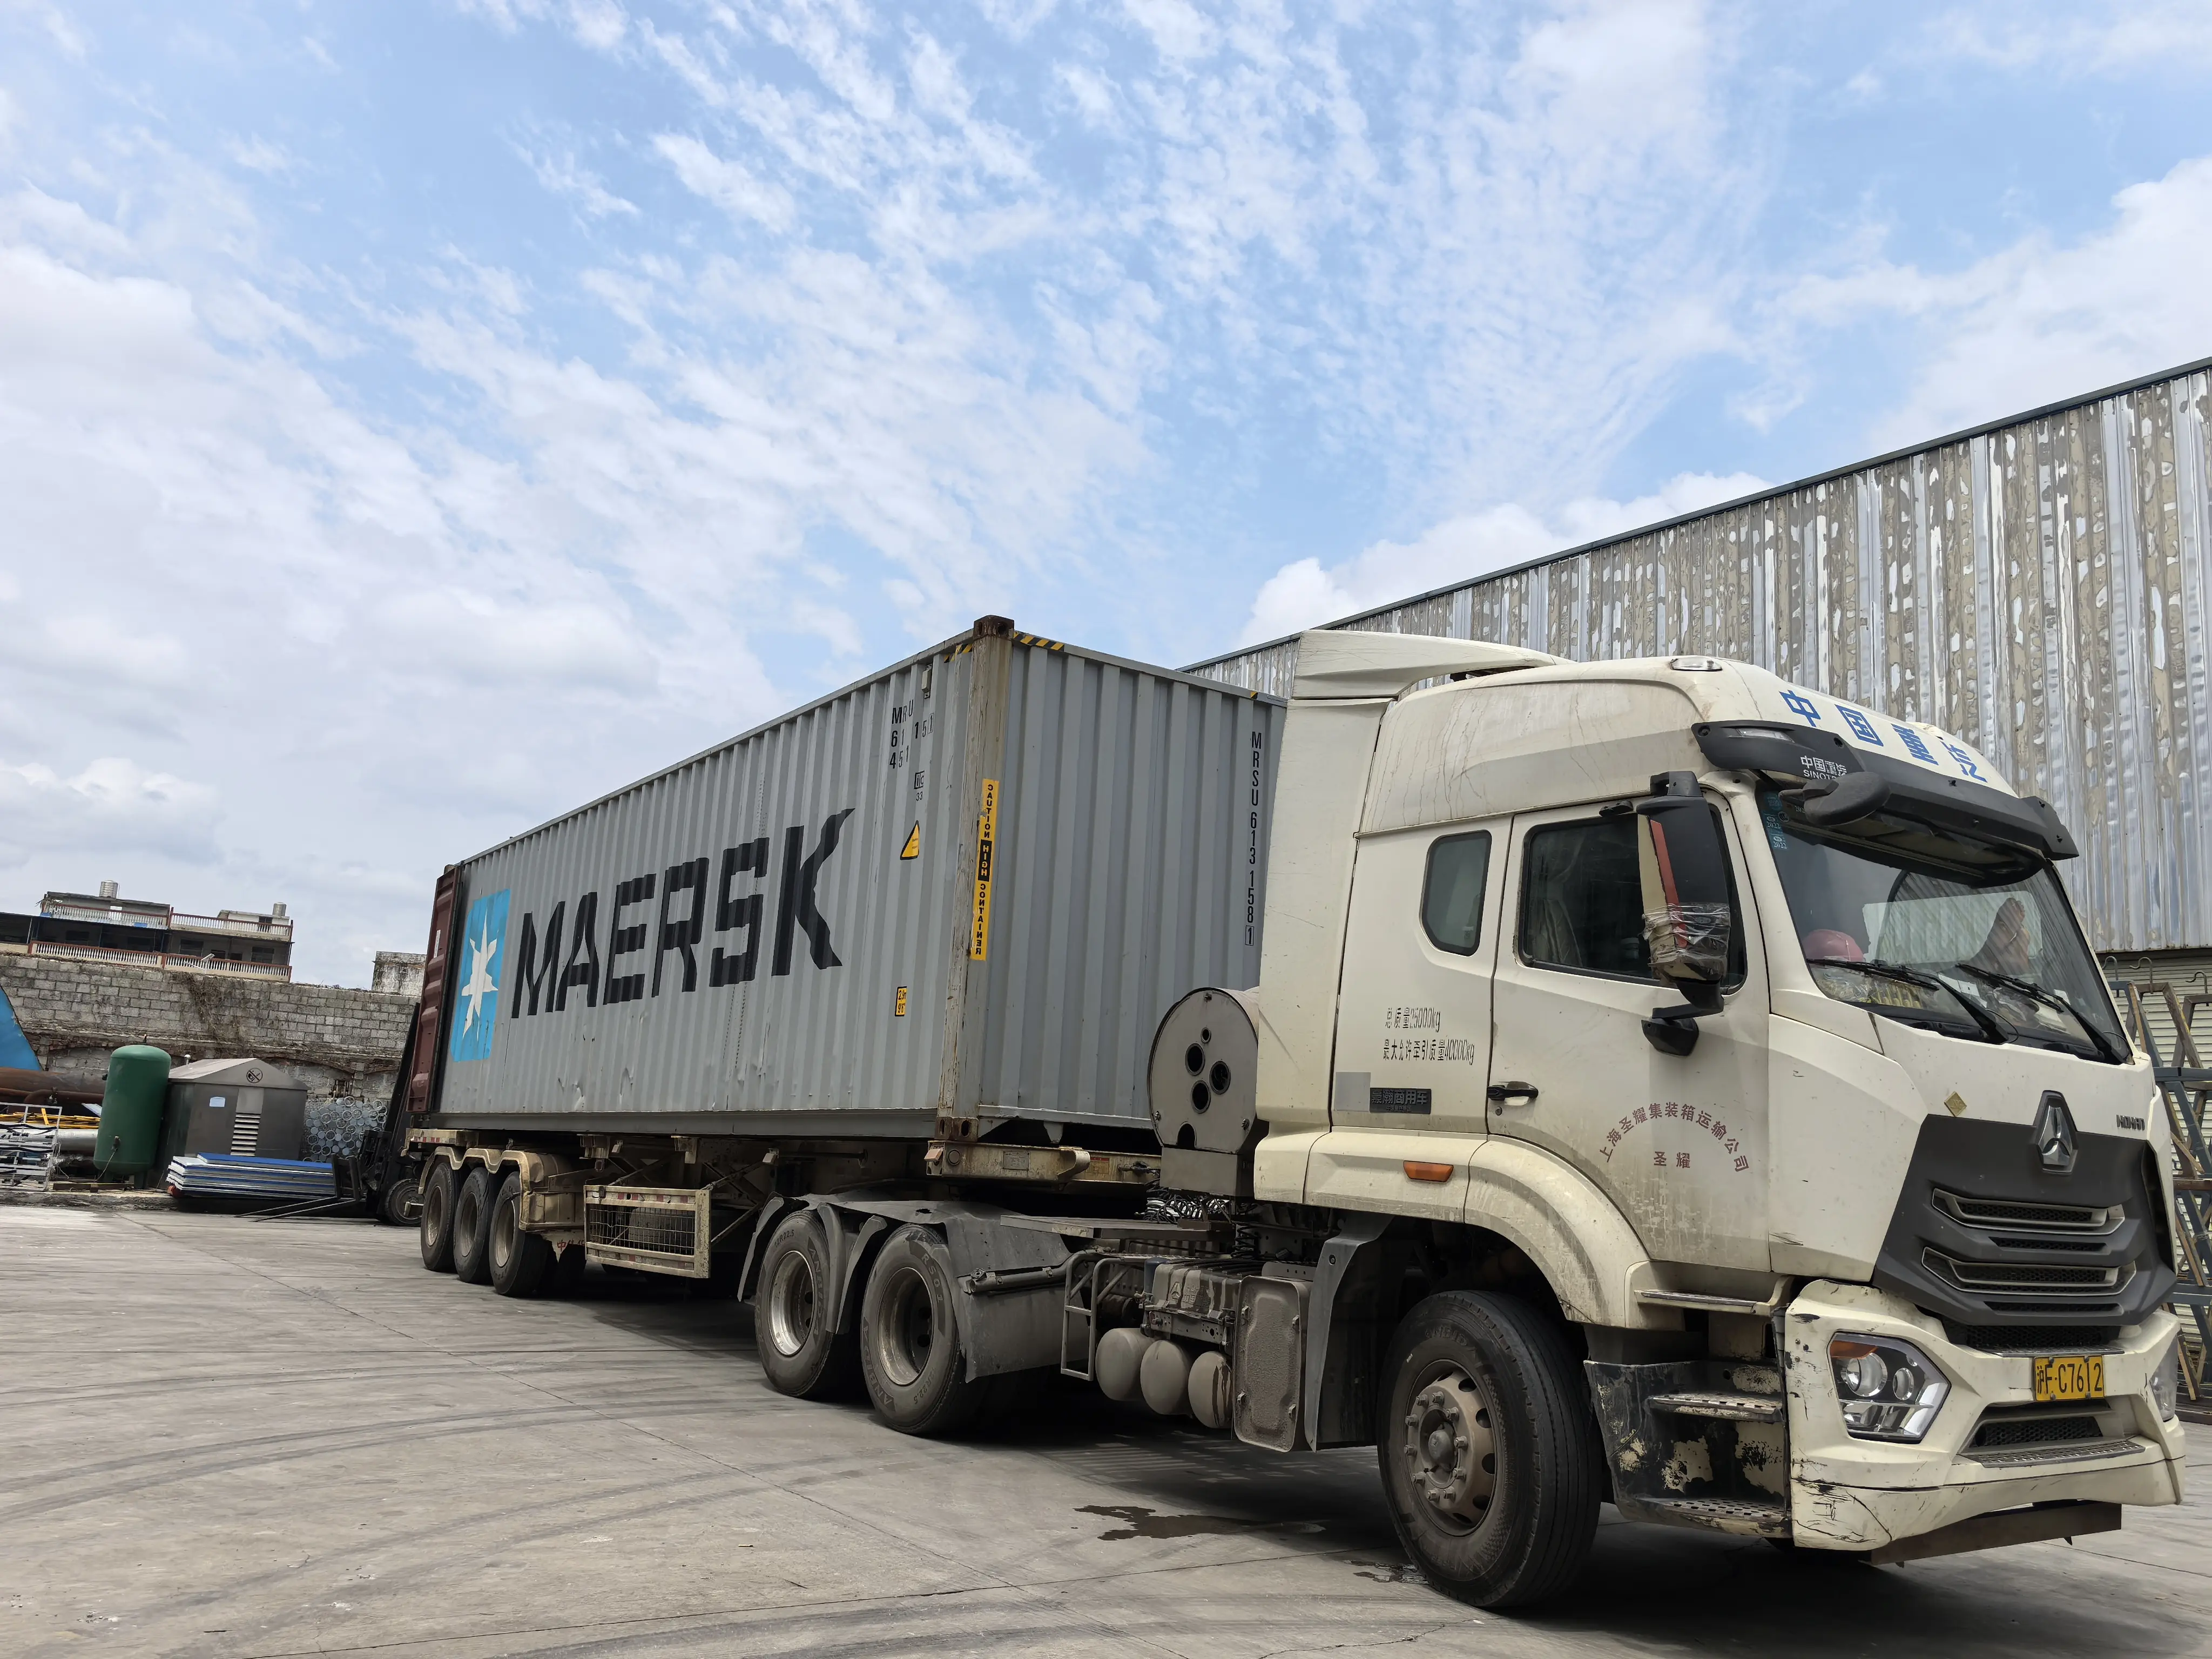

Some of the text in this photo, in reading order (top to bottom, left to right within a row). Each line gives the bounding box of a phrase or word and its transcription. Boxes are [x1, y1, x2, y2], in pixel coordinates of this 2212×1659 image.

[1251, 731, 1262, 807] MRSU
[1778, 689, 1988, 783] 中国重汽
[916, 791, 923, 801] 33
[1803, 769, 1837, 780] SINOT
[511, 808, 855, 1019] MAERSK
